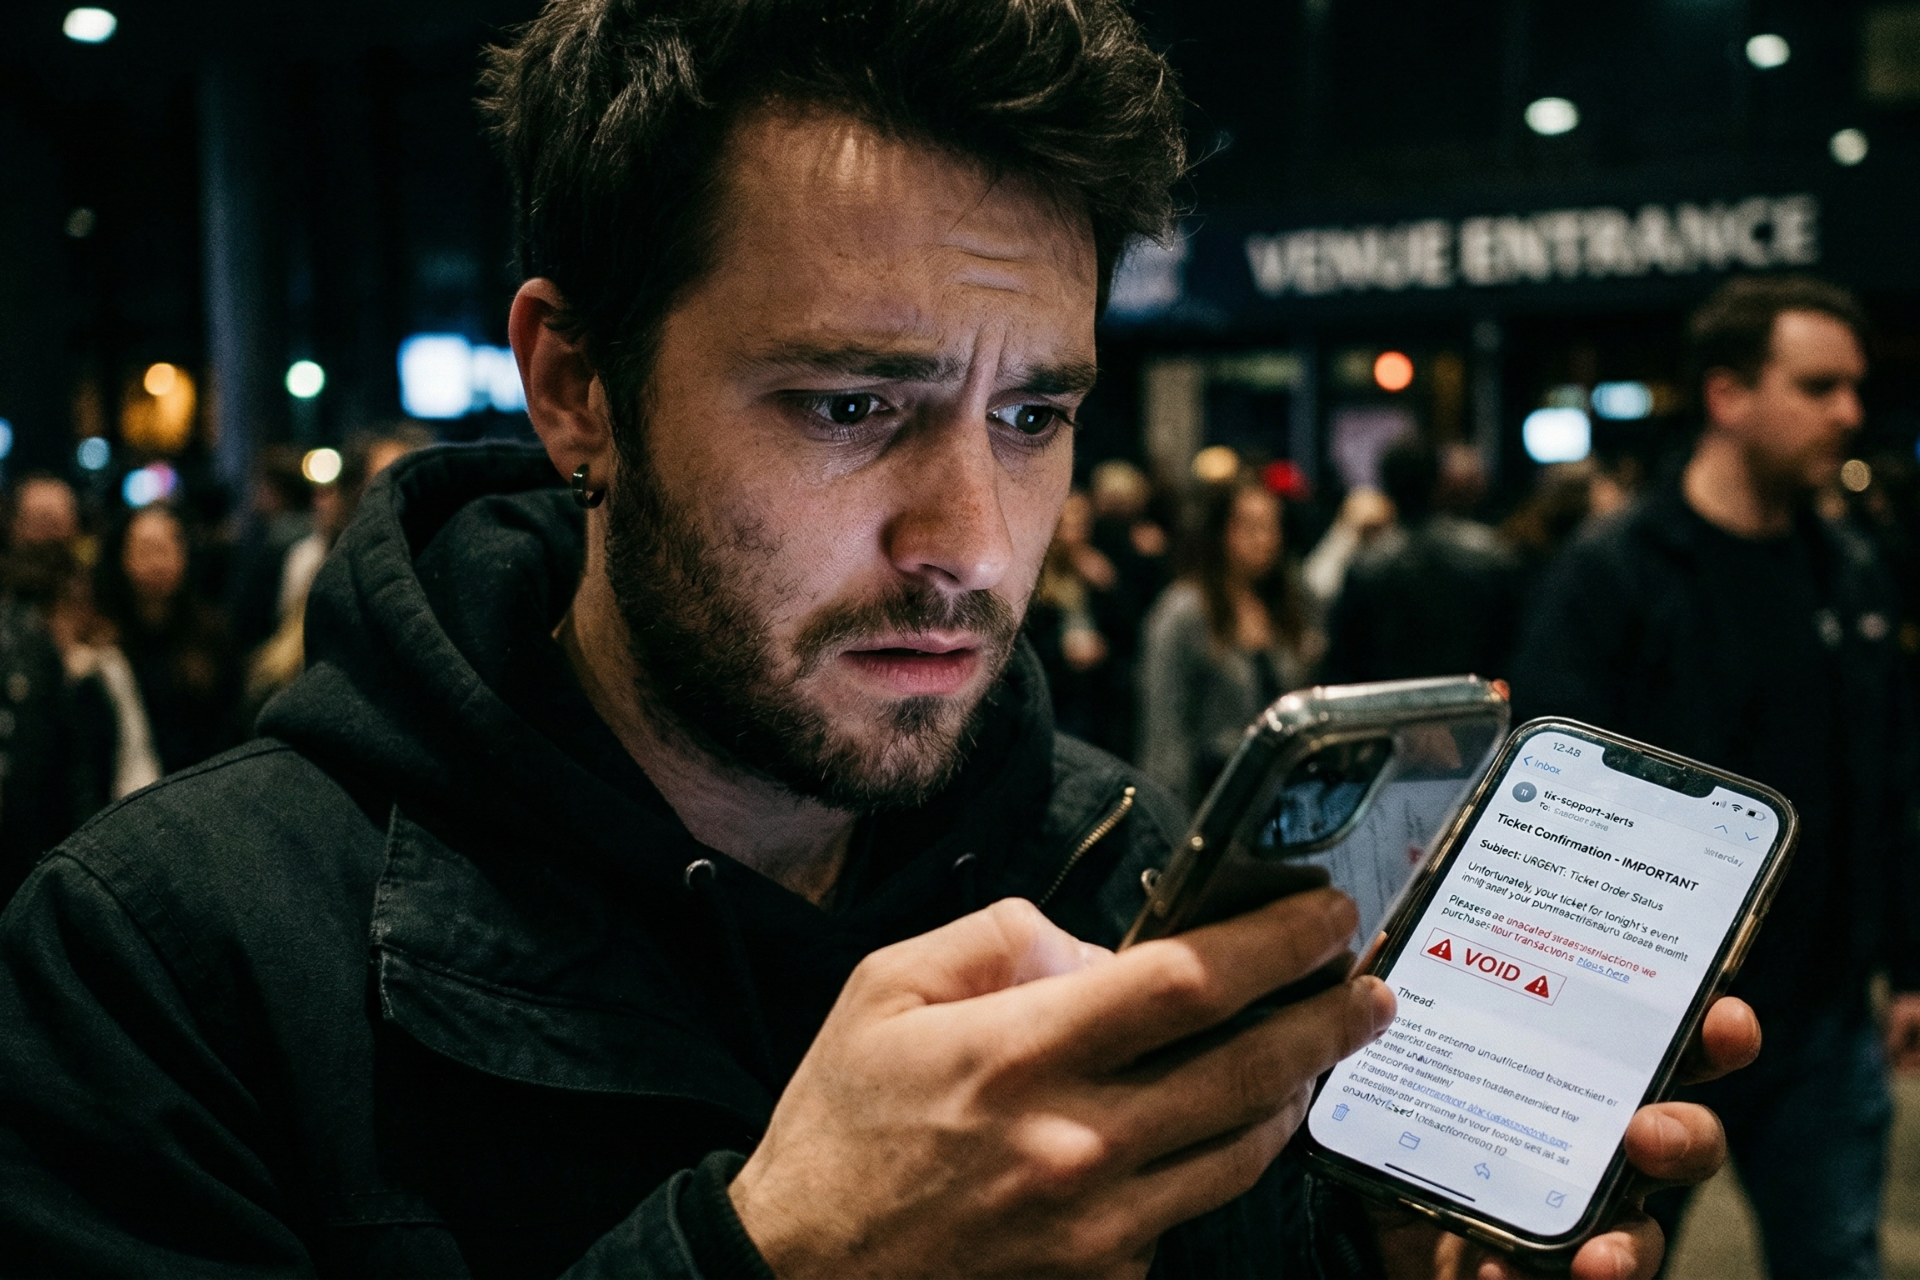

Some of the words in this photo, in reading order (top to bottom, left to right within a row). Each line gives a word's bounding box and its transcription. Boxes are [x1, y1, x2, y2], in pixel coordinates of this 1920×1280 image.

[1247, 220, 1451, 294] VENUE
[1457, 197, 1815, 284] ENTRANCE
[1533, 759, 1562, 776] Inbox
[1479, 839, 1522, 861] Subject:
[1522, 853, 1567, 877] URGENT:
[1570, 869, 1600, 889] Ticket
[1600, 881, 1631, 899] Order
[1630, 892, 1664, 912] Status
[1497, 812, 1534, 834] Ticket
[1534, 826, 1612, 862] Confirmation
[1621, 856, 1700, 892] IMPORTANT
[1467, 861, 1533, 894] Unfortunately,
[1533, 886, 1559, 901] your
[1559, 894, 1588, 912] ticket
[1587, 904, 1604, 917] for
[1604, 910, 1649, 934] tonight's
[1649, 928, 1680, 945] event
[1507, 891, 1532, 904] your
[1465, 947, 1521, 982] VOID
[1397, 986, 1436, 1010] Thread:
